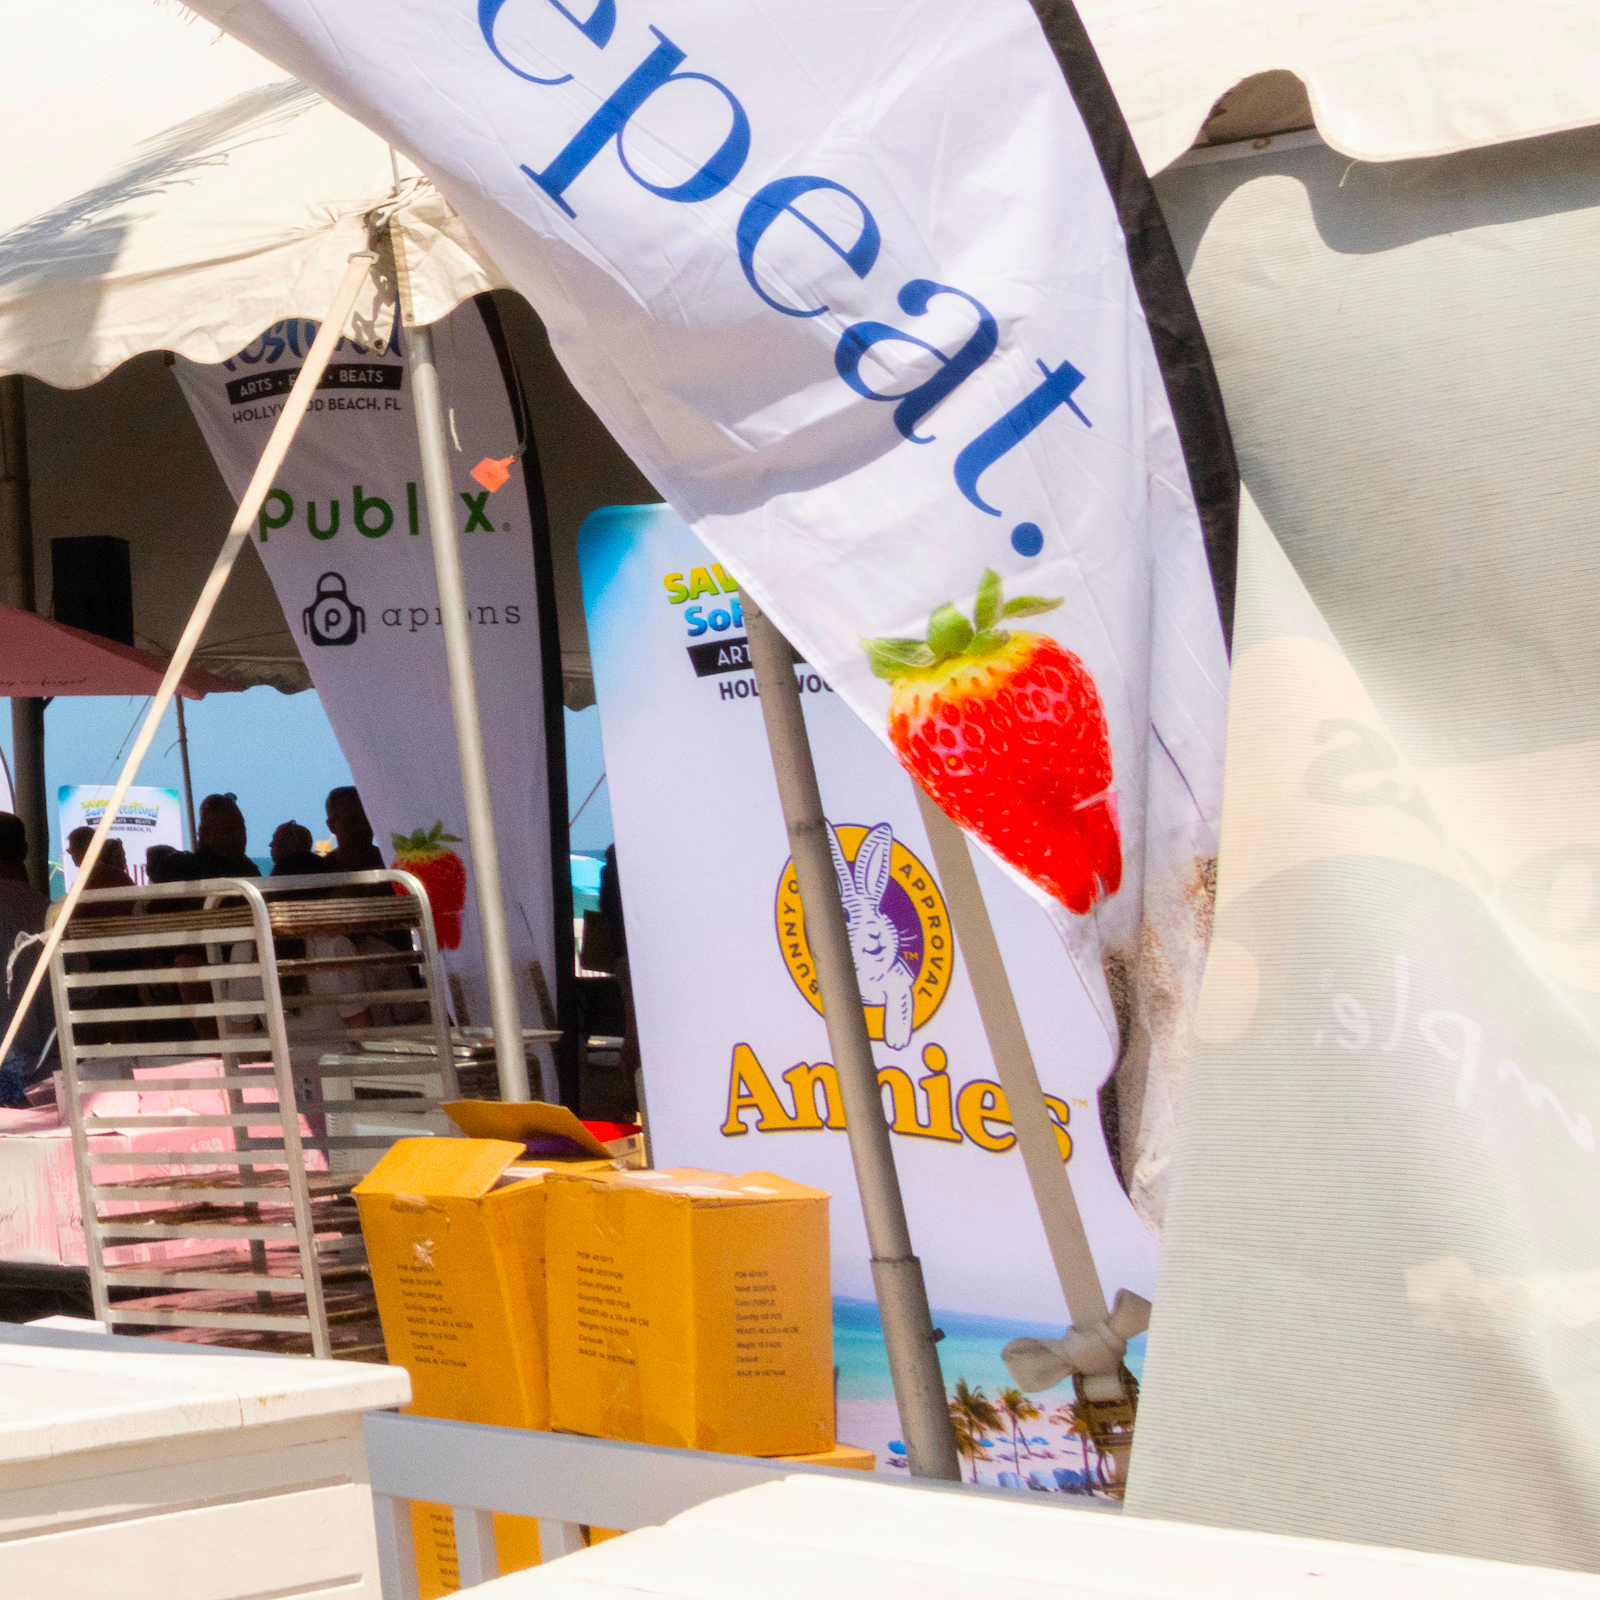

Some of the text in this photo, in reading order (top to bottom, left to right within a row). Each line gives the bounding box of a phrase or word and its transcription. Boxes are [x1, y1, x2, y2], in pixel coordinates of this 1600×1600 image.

[238, 369, 384, 398] ARTS BEATS
[328, 398, 383, 412] BEACH,
[384, 397, 402, 411] FL
[258, 482, 496, 542] Publx
[663, 563, 739, 604] SAV
[684, 597, 744, 637] SoF
[717, 644, 751, 666] ART
[899, 862, 945, 999] APPROVAL
